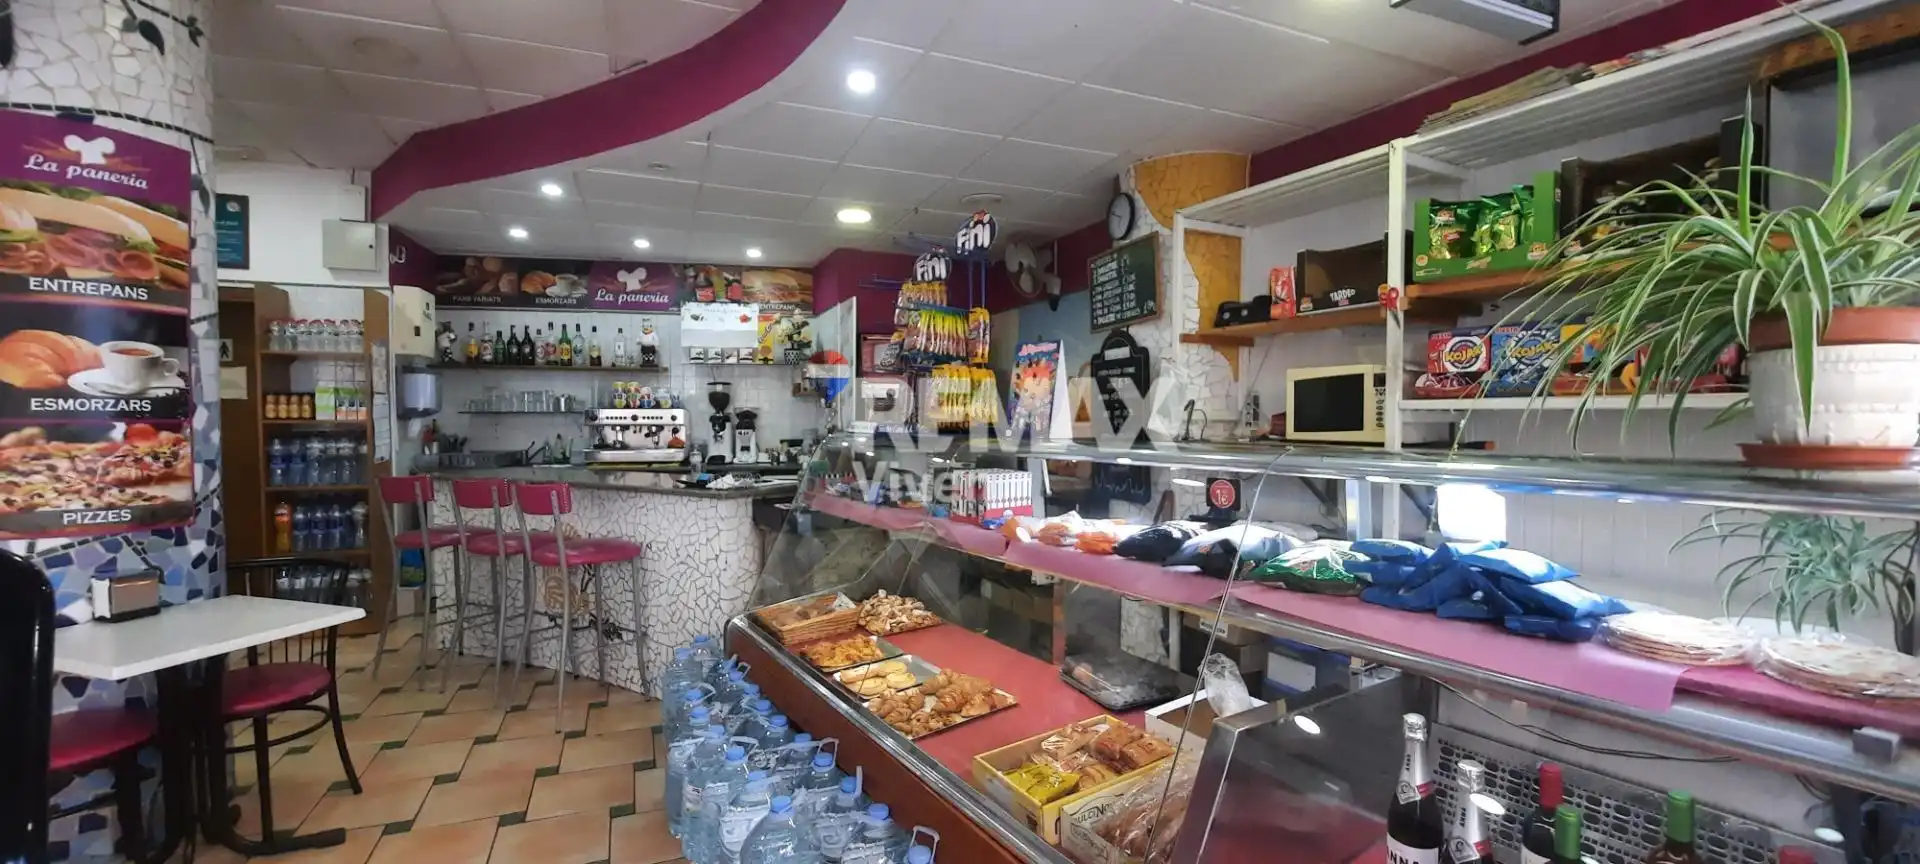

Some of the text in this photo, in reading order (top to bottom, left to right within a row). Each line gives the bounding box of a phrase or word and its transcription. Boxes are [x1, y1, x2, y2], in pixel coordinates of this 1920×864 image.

[24, 153, 149, 190] La paneria
[957, 214, 991, 254] Fini
[916, 253, 948, 282] Fini
[28, 276, 149, 301] ENTREPANS
[594, 288, 669, 305] La paneria
[473, 294, 502, 304] VARIATS
[535, 296, 577, 305] ESMORZARS
[30, 397, 152, 412] ESMORZARS
[1215, 489, 1229, 505] 1€
[62, 508, 132, 525] PIZZES
